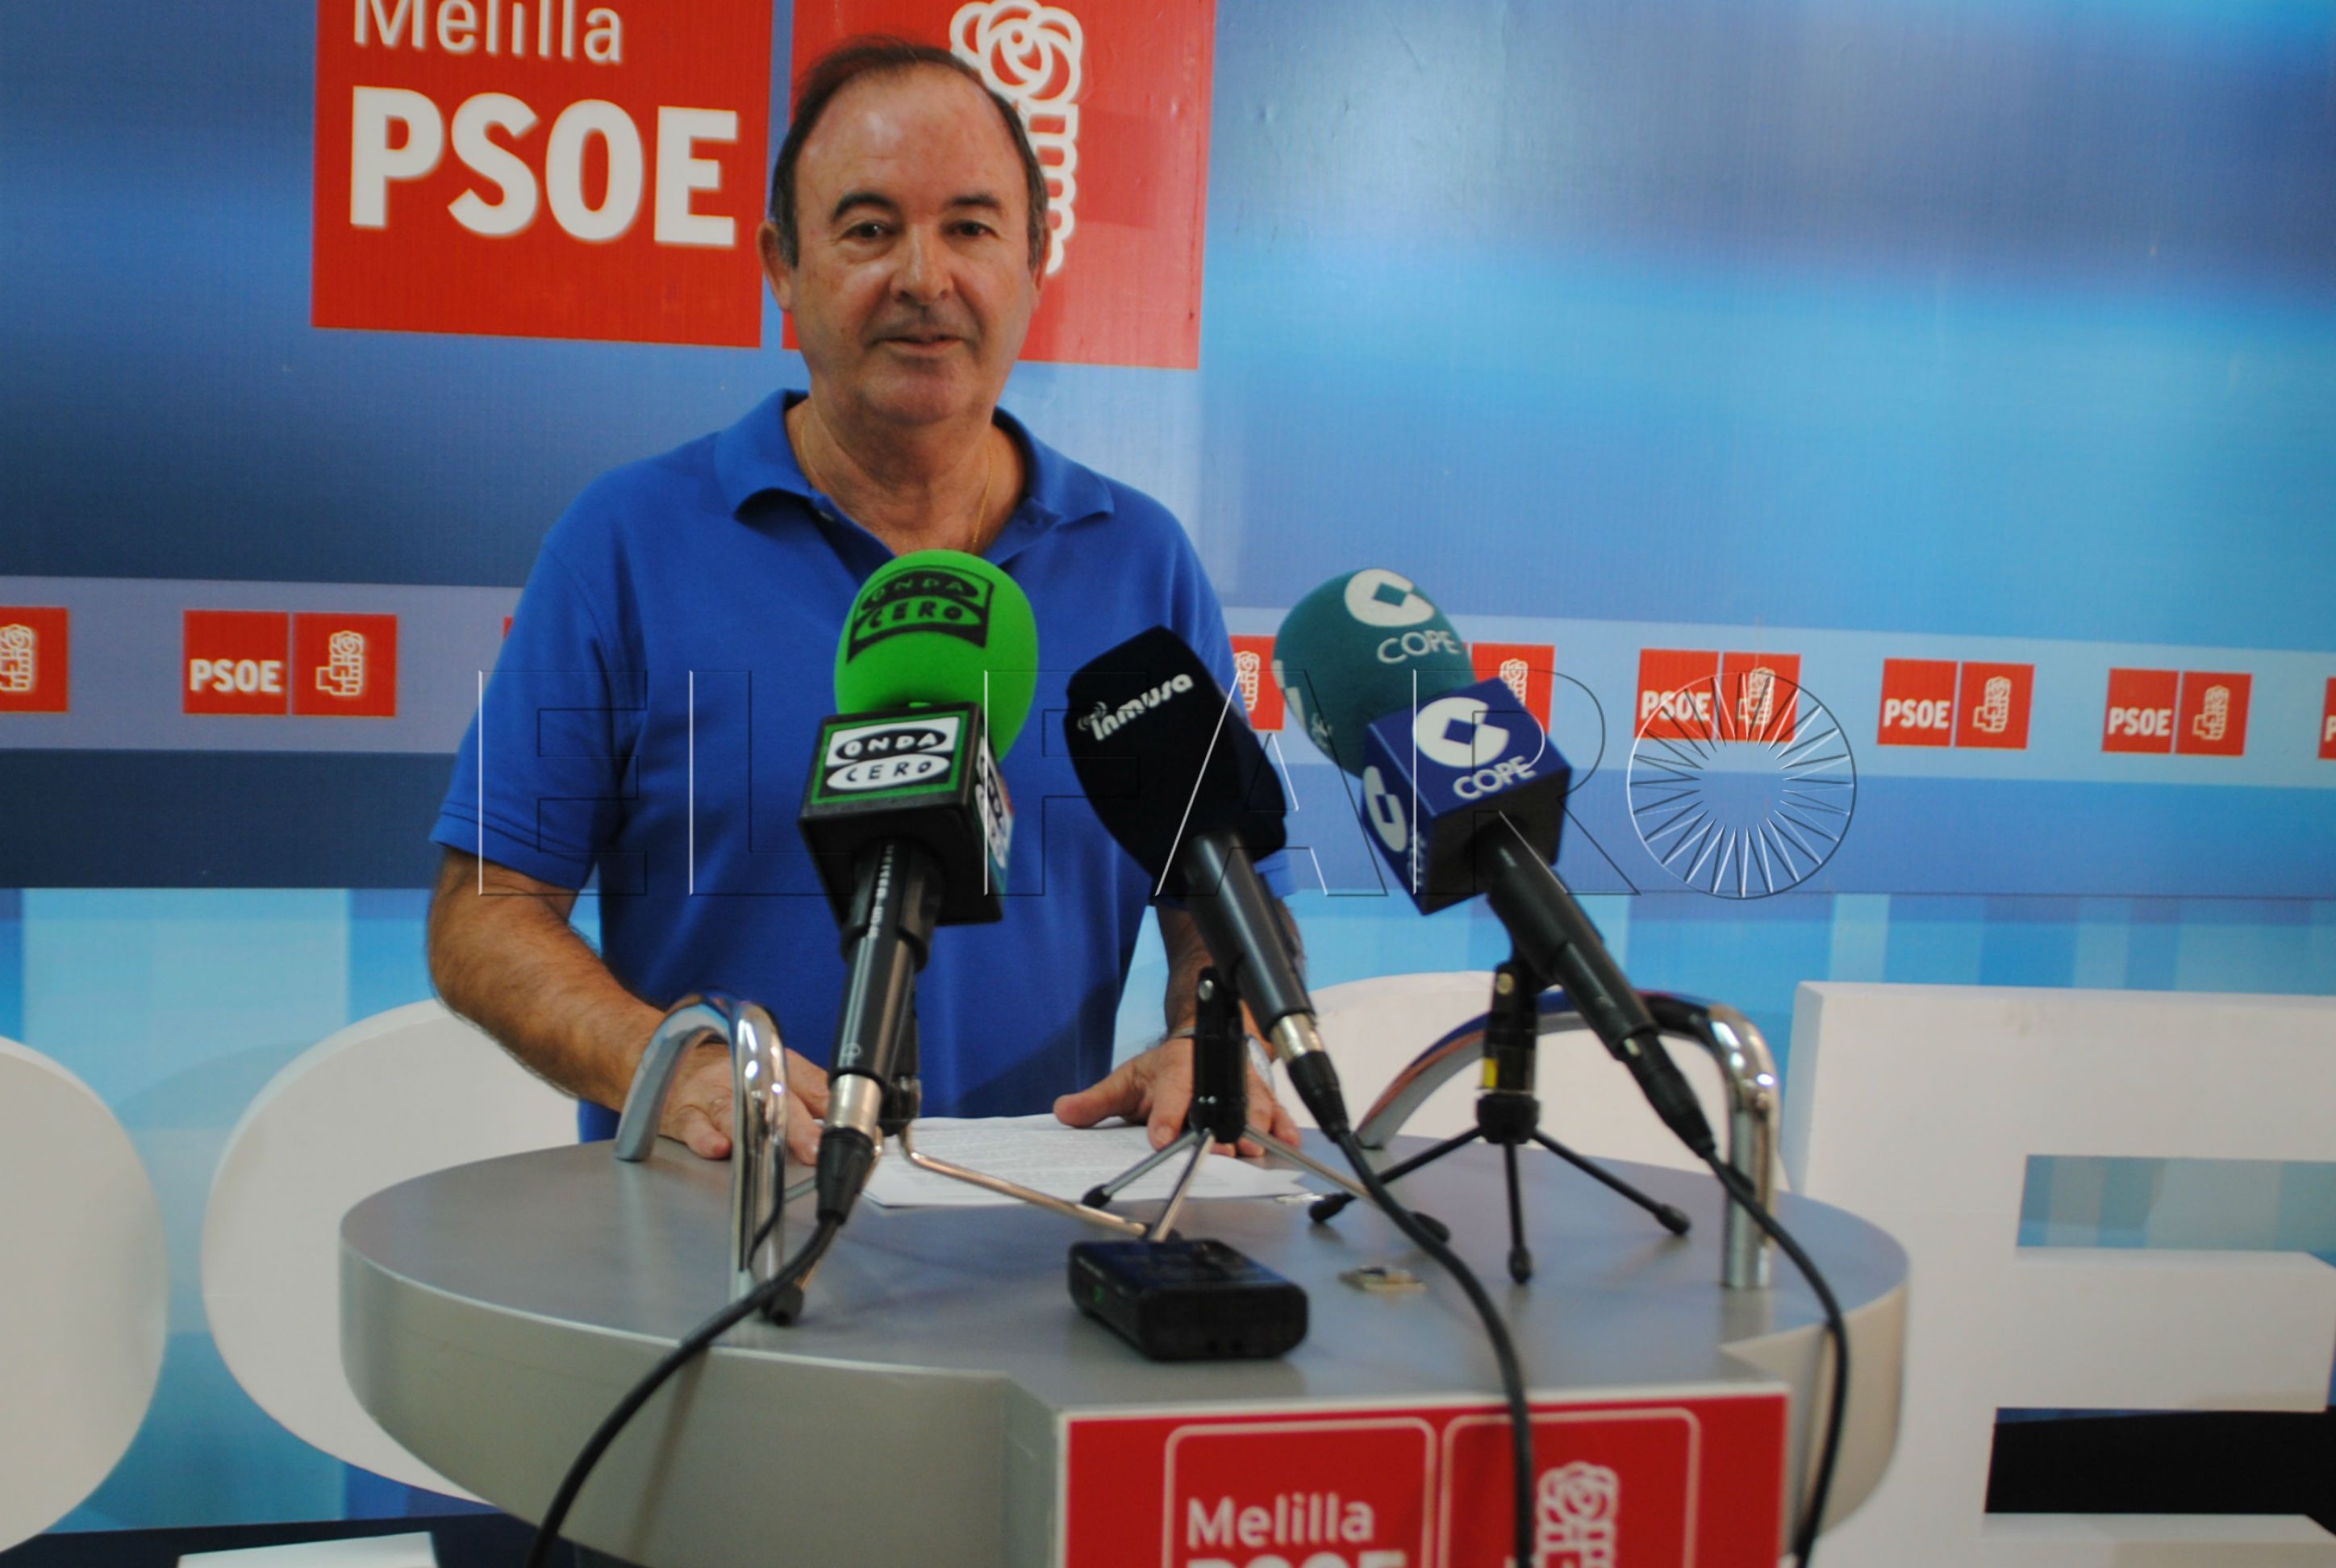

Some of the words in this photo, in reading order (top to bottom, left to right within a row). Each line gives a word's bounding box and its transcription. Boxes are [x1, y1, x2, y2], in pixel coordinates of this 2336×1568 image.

[353, 0, 624, 64] Melilla
[350, 85, 737, 249] PSOE
[870, 576, 965, 602] ONDA
[868, 600, 964, 629] CERO
[1377, 629, 1460, 664] COPE
[190, 658, 282, 694] PSOE
[1089, 673, 1194, 741] inmusa
[1641, 690, 1711, 722] PSOE
[1883, 698, 1951, 729] PSOE
[2108, 706, 2171, 736] PSOE
[844, 732, 938, 757] ONDA
[846, 761, 932, 782] CERO
[1454, 755, 1537, 800] COPE
[1187, 1491, 1375, 1549] Melilla
